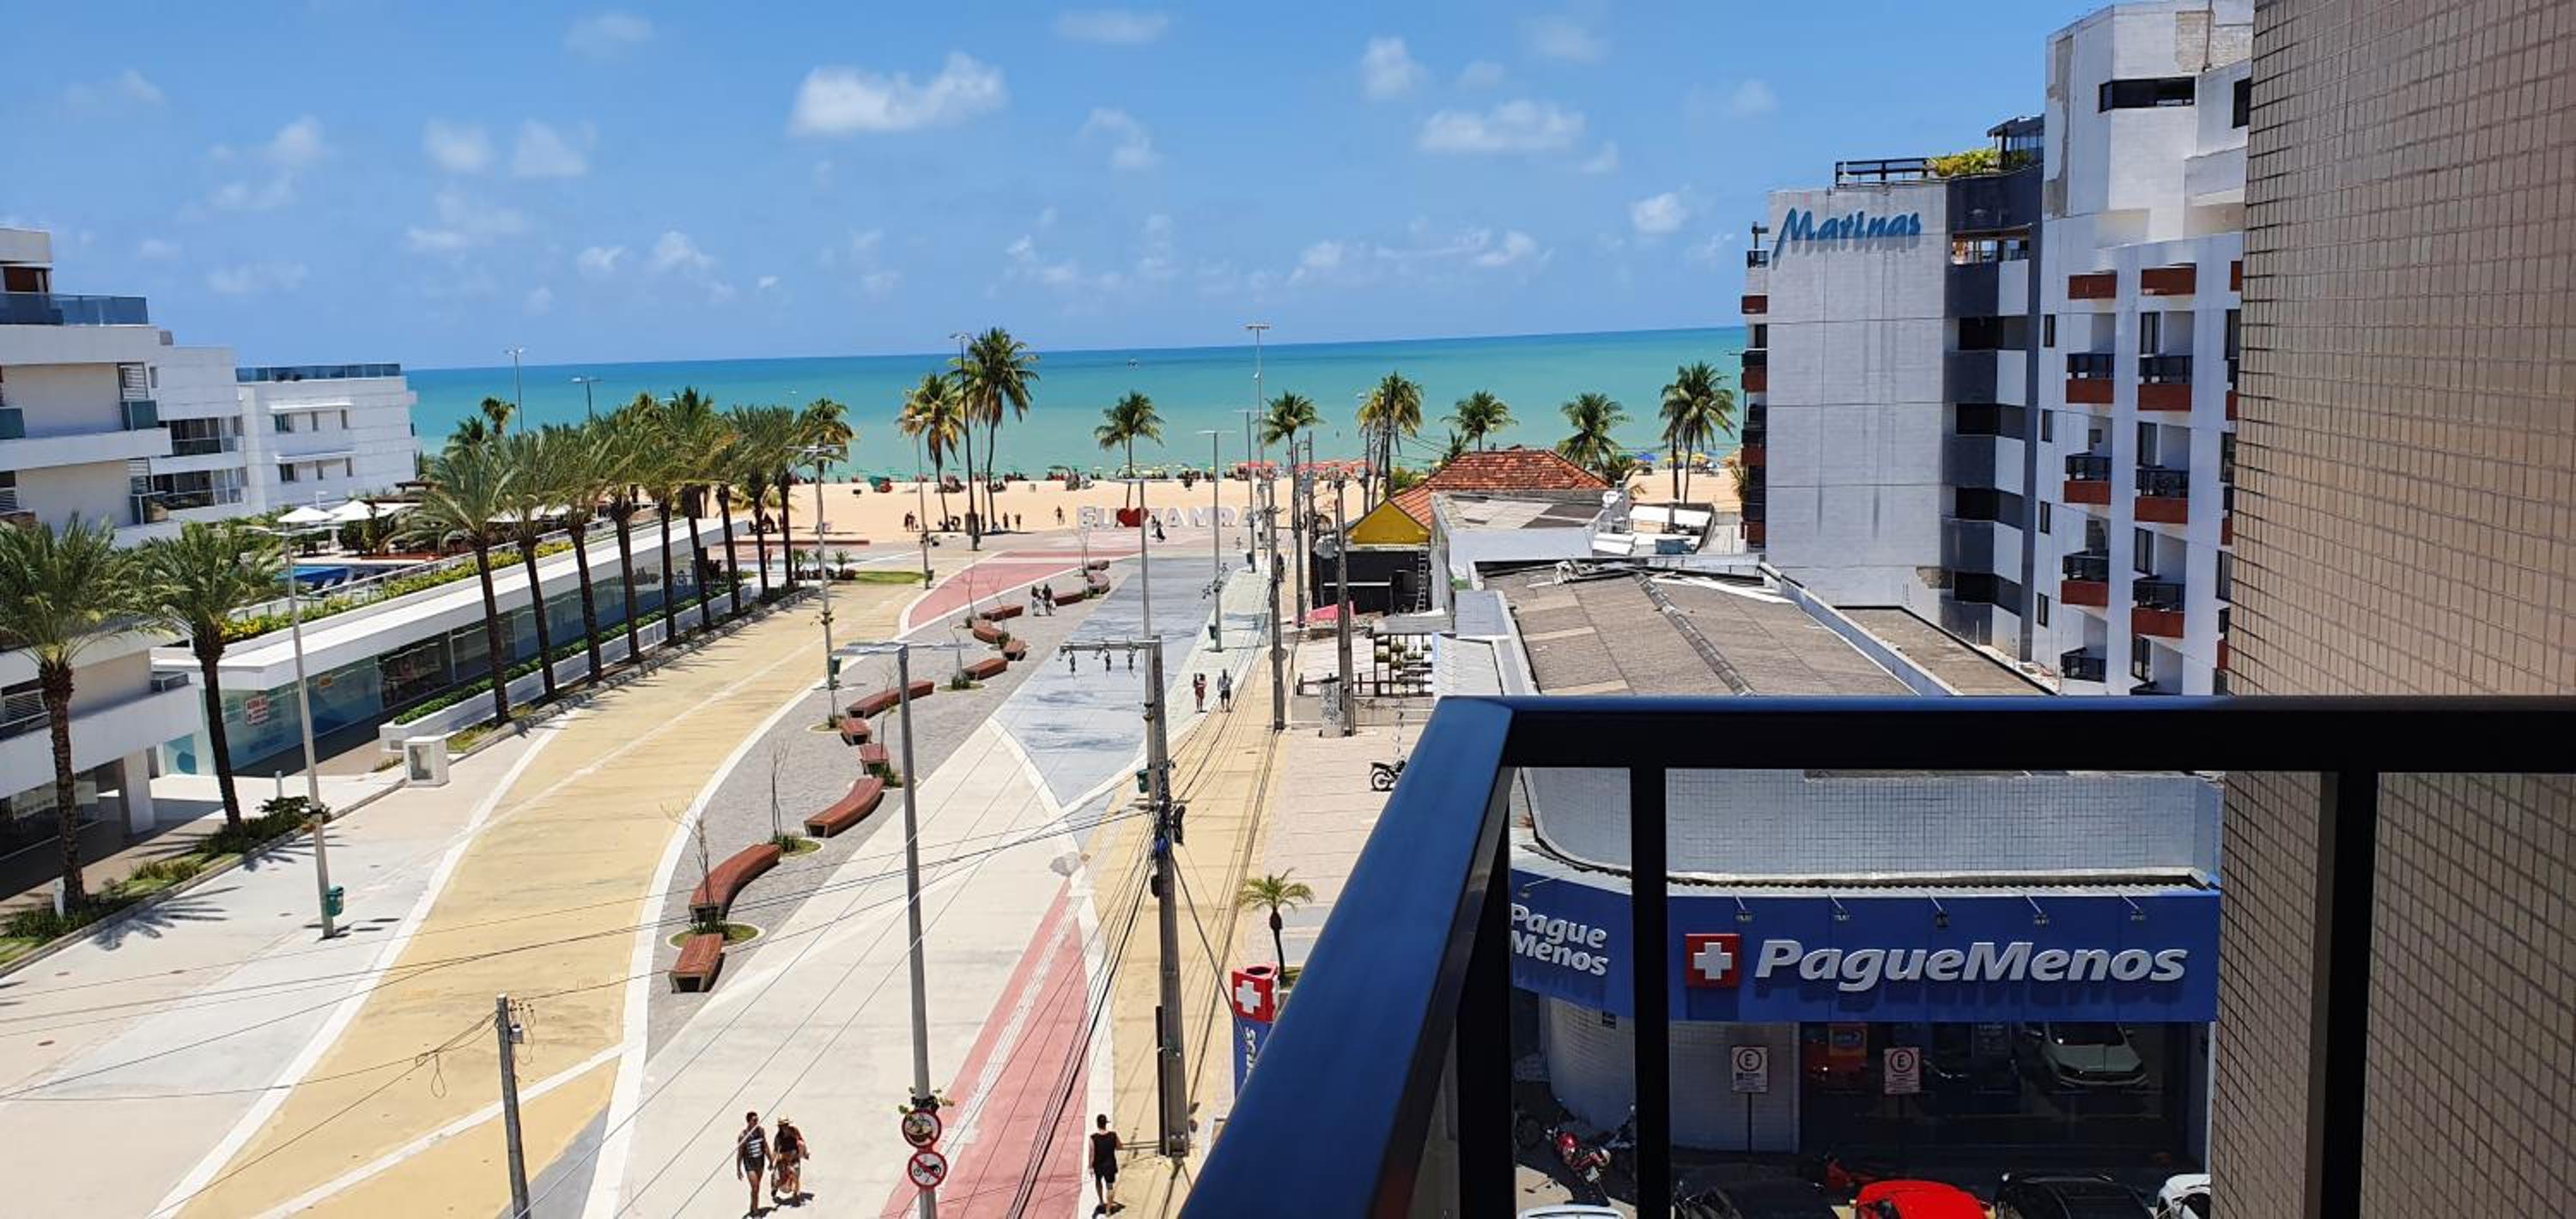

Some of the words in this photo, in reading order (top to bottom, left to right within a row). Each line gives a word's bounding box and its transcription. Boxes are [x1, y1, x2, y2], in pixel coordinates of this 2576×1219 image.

[1772, 207, 1921, 258] Marinas
[1511, 902, 1607, 948] Pague
[1511, 930, 1609, 976] Menos
[1755, 939, 2188, 992] PagueMenos
[1744, 1053, 1754, 1067] E
[1898, 1054, 1907, 1068] E
